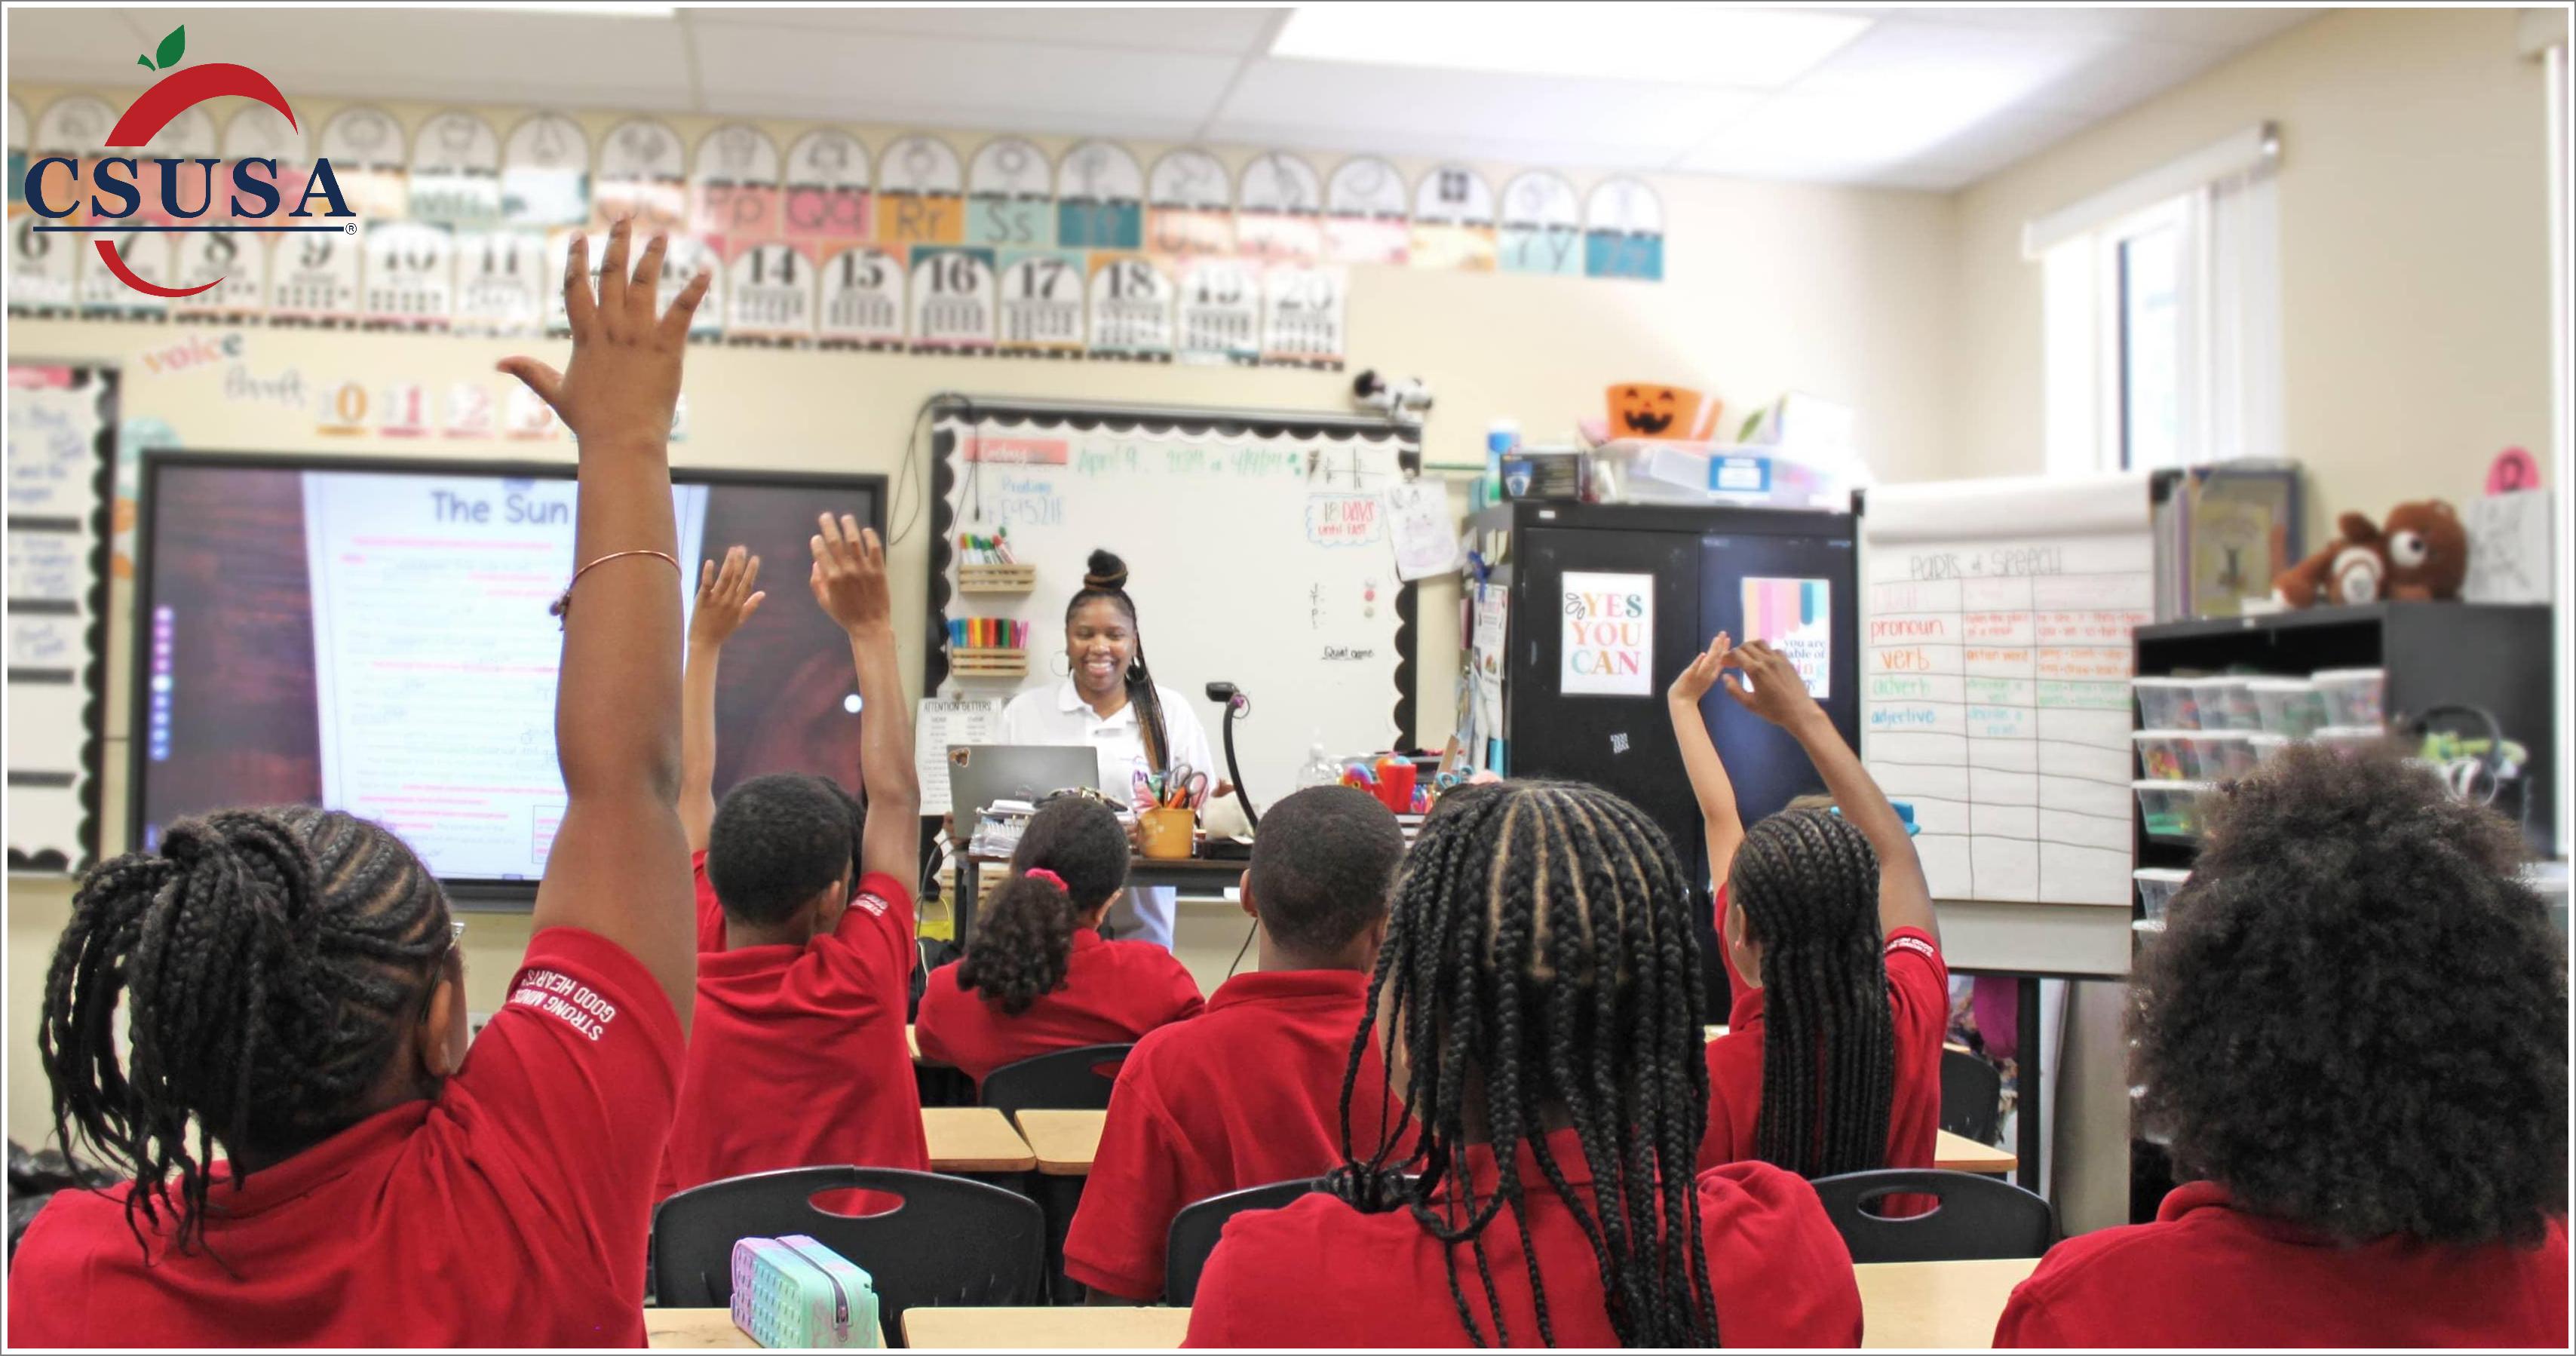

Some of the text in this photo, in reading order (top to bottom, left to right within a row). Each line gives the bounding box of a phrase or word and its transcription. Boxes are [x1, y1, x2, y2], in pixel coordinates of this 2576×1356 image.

[986, 201, 1033, 244] Ss
[752, 247, 796, 284] 14
[842, 247, 885, 288] 15
[928, 252, 977, 294] 16
[1020, 258, 1059, 299] 17
[1109, 259, 1154, 299] 18
[431, 490, 569, 526] The Sun
[1583, 592, 1643, 618] YES
[1571, 621, 1642, 647] YOU
[1871, 618, 1945, 644] pronoun
[1571, 649, 1641, 676] CAN
[1881, 646, 1930, 670] verb
[1873, 676, 1930, 695] adverb
[924, 701, 992, 713] ATTENTION GETTERS
[1871, 707, 1936, 729] adjective
[573, 987, 616, 1023] GOOD
[543, 996, 603, 1041] STRONG
